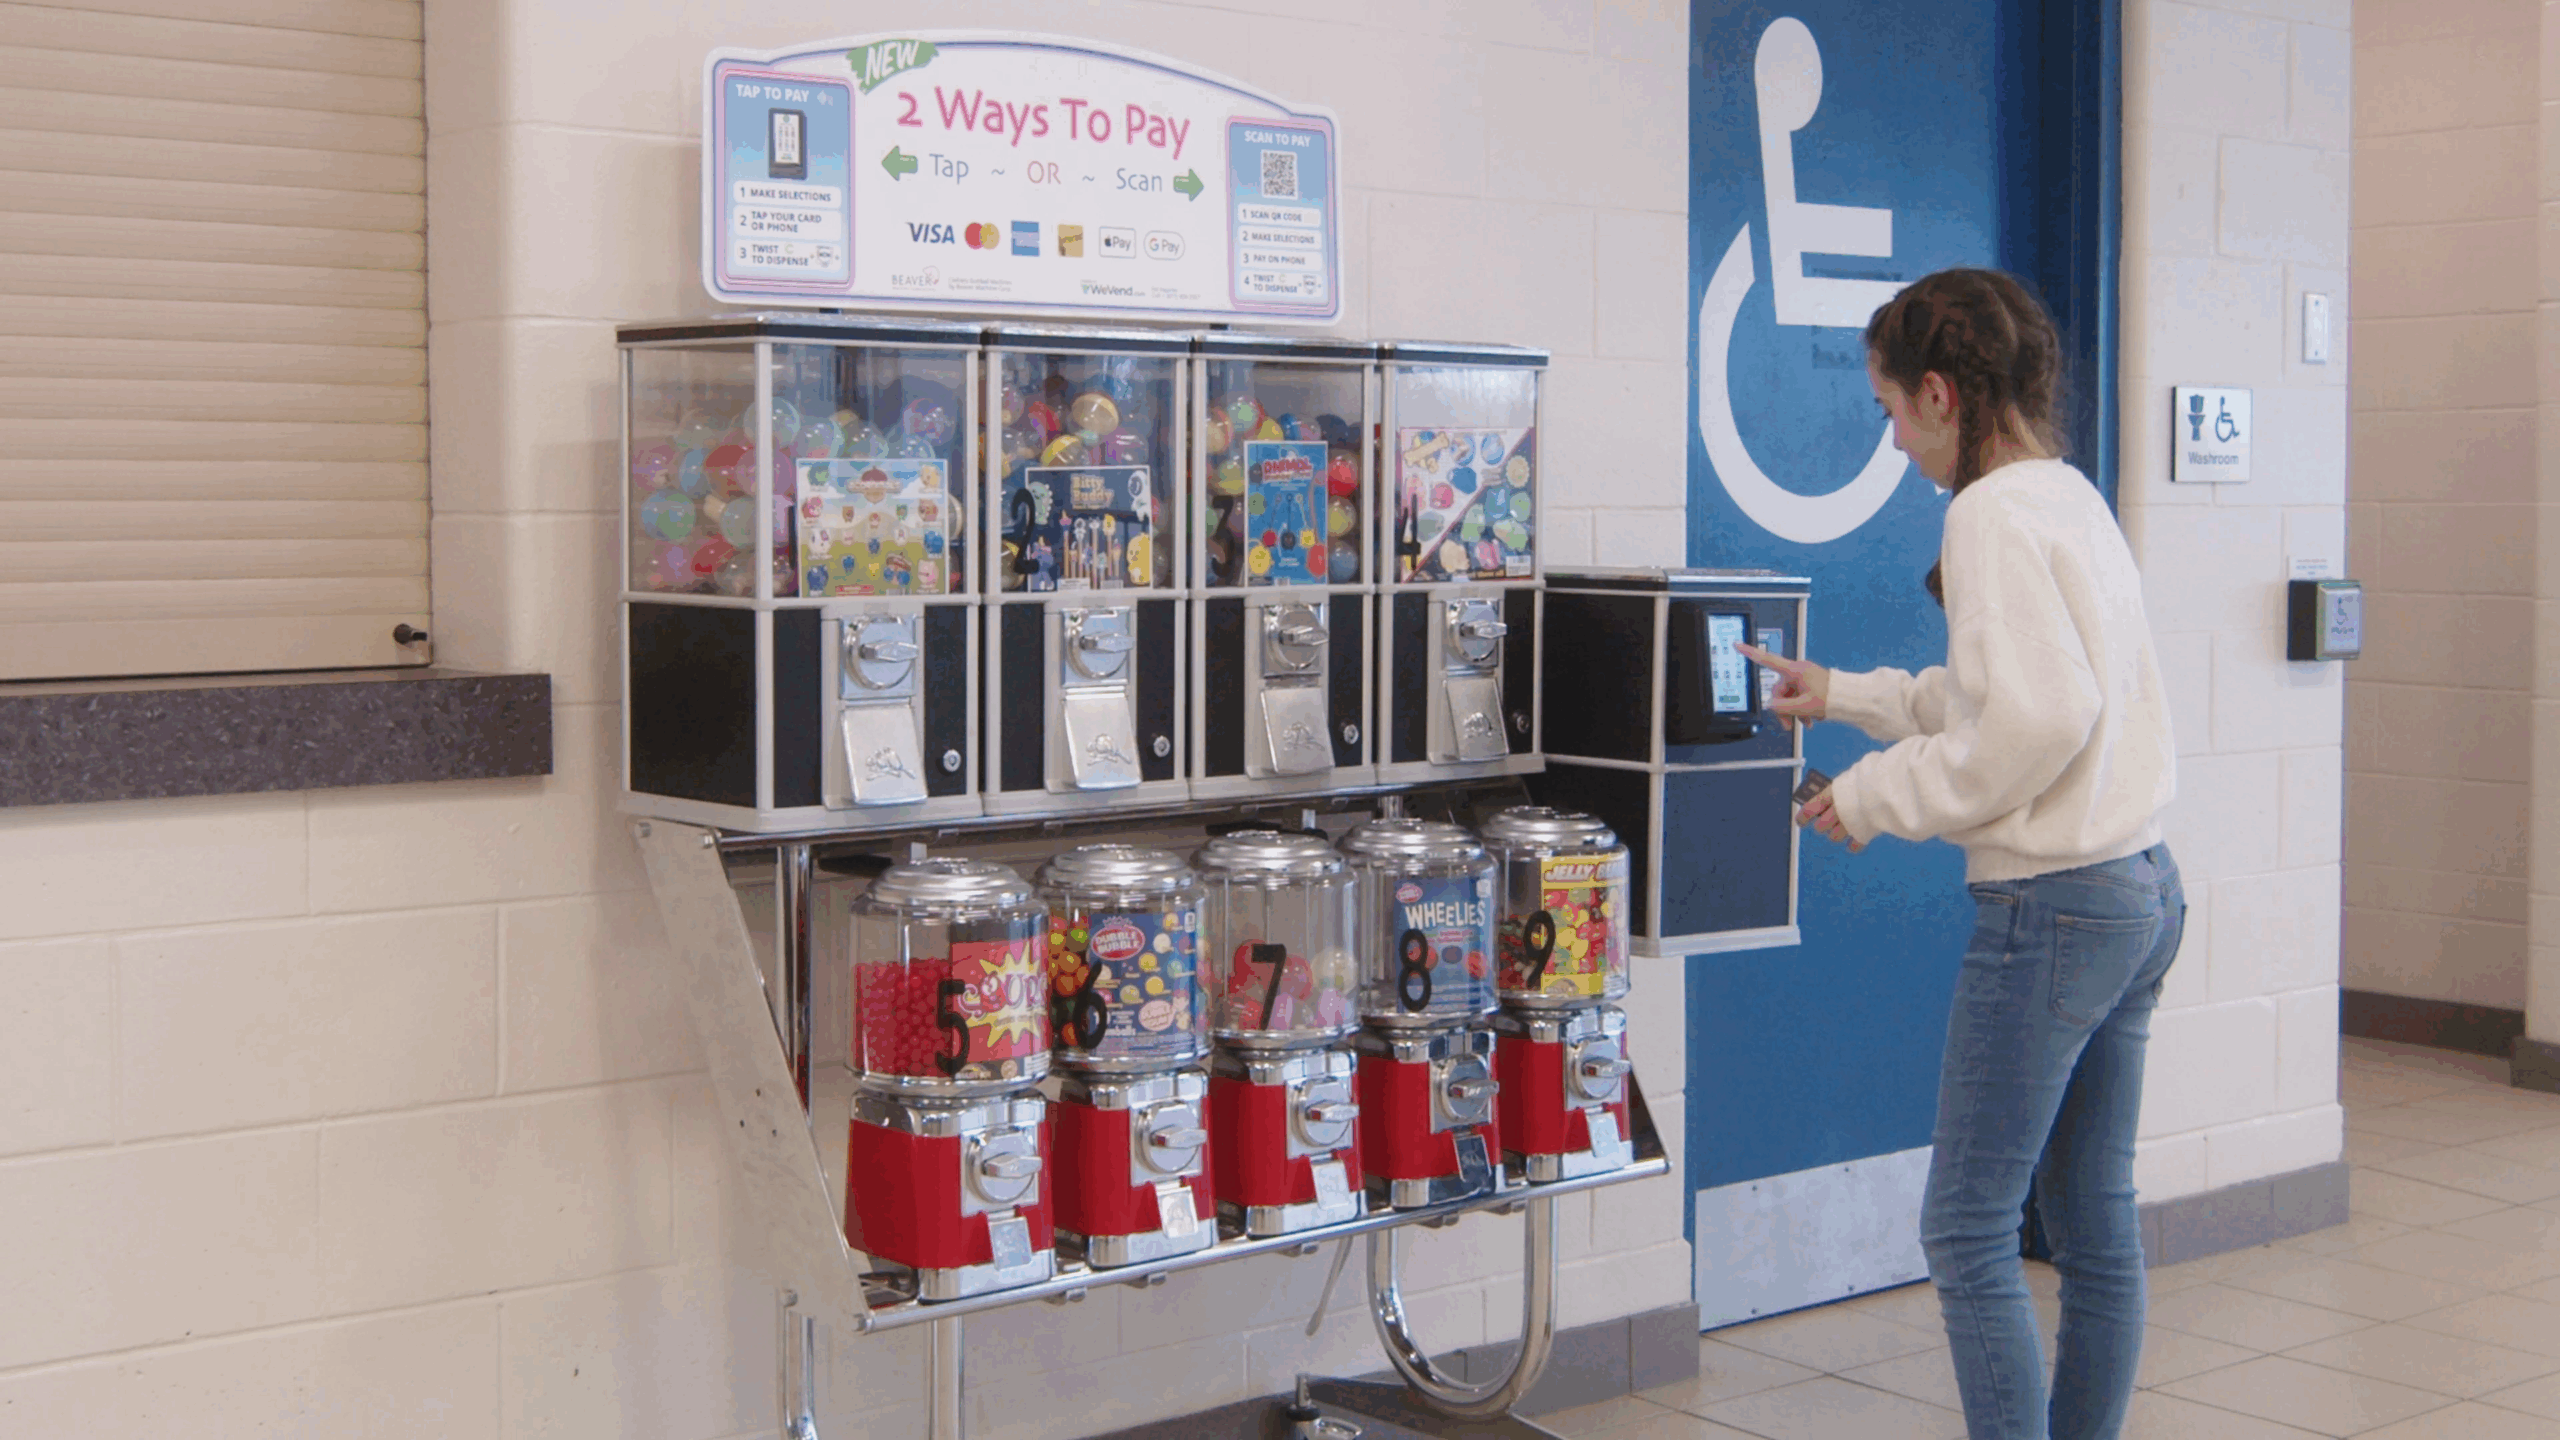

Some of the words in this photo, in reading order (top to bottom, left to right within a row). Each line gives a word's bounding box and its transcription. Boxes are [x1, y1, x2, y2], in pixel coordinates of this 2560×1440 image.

[865, 41, 920, 86] NEW
[736, 84, 760, 98] TAP
[764, 87, 782, 100] TO
[785, 89, 809, 102] PAY
[897, 91, 923, 127] 2
[934, 86, 1049, 147] Ways
[1060, 97, 1111, 142] To
[1125, 104, 1191, 160] Pay
[1244, 130, 1273, 144] SCAN
[1275, 133, 1289, 145] TO
[1291, 134, 1311, 147] PAY
[929, 153, 969, 185] Tap
[1027, 161, 1061, 185] OR
[1116, 168, 1162, 192] Scan
[740, 187, 745, 197] 1
[750, 189, 776, 198] MAKE
[778, 190, 831, 202] SELECTIONS
[740, 215, 747, 226] 2
[751, 211, 768, 219] TAP
[770, 212, 795, 221] YOUR
[798, 214, 822, 223] CARD
[1242, 208, 1247, 218] 1
[1250, 211, 1269, 219] SCAN
[1283, 213, 1302, 222] CODE
[751, 222, 764, 231] OR
[767, 223, 798, 233] PHONE
[905, 222, 955, 244] VISA
[1112, 236, 1131, 251] Pay
[1242, 231, 1248, 241] 2
[1251, 232, 1271, 242] MAKE
[1273, 234, 1315, 244] SELECTIONS
[740, 247, 747, 259] 3
[752, 244, 779, 254] TWIST
[1149, 238, 1159, 251] G
[1161, 239, 1180, 255] Pay
[752, 255, 764, 264] TO
[767, 256, 808, 266] DISPENSE
[1243, 253, 1249, 264] 3
[1253, 254, 1266, 263] PAY
[1268, 255, 1279, 263] ON
[1281, 255, 1305, 265] PHONE
[891, 274, 932, 286] BEAVER
[1244, 276, 1250, 286] 4
[1253, 274, 1274, 283] TWIST
[1254, 283, 1263, 292] TO
[1265, 284, 1297, 293] DISPENSE
[2187, 451, 2239, 465] Washroom
[1011, 488, 1039, 574] 2
[1211, 494, 1235, 578] 3
[1544, 864, 1595, 882] JELLY
[1405, 900, 1486, 930] WHEELIES
[1095, 931, 1137, 944] DUBBLE
[1097, 940, 1140, 953] BUBBLE
[1523, 910, 1556, 989] 9
[1399, 928, 1432, 1011] 8
[1251, 943, 1287, 1031] 7
[1074, 960, 1107, 1049] 6
[936, 979, 970, 1078] 5
